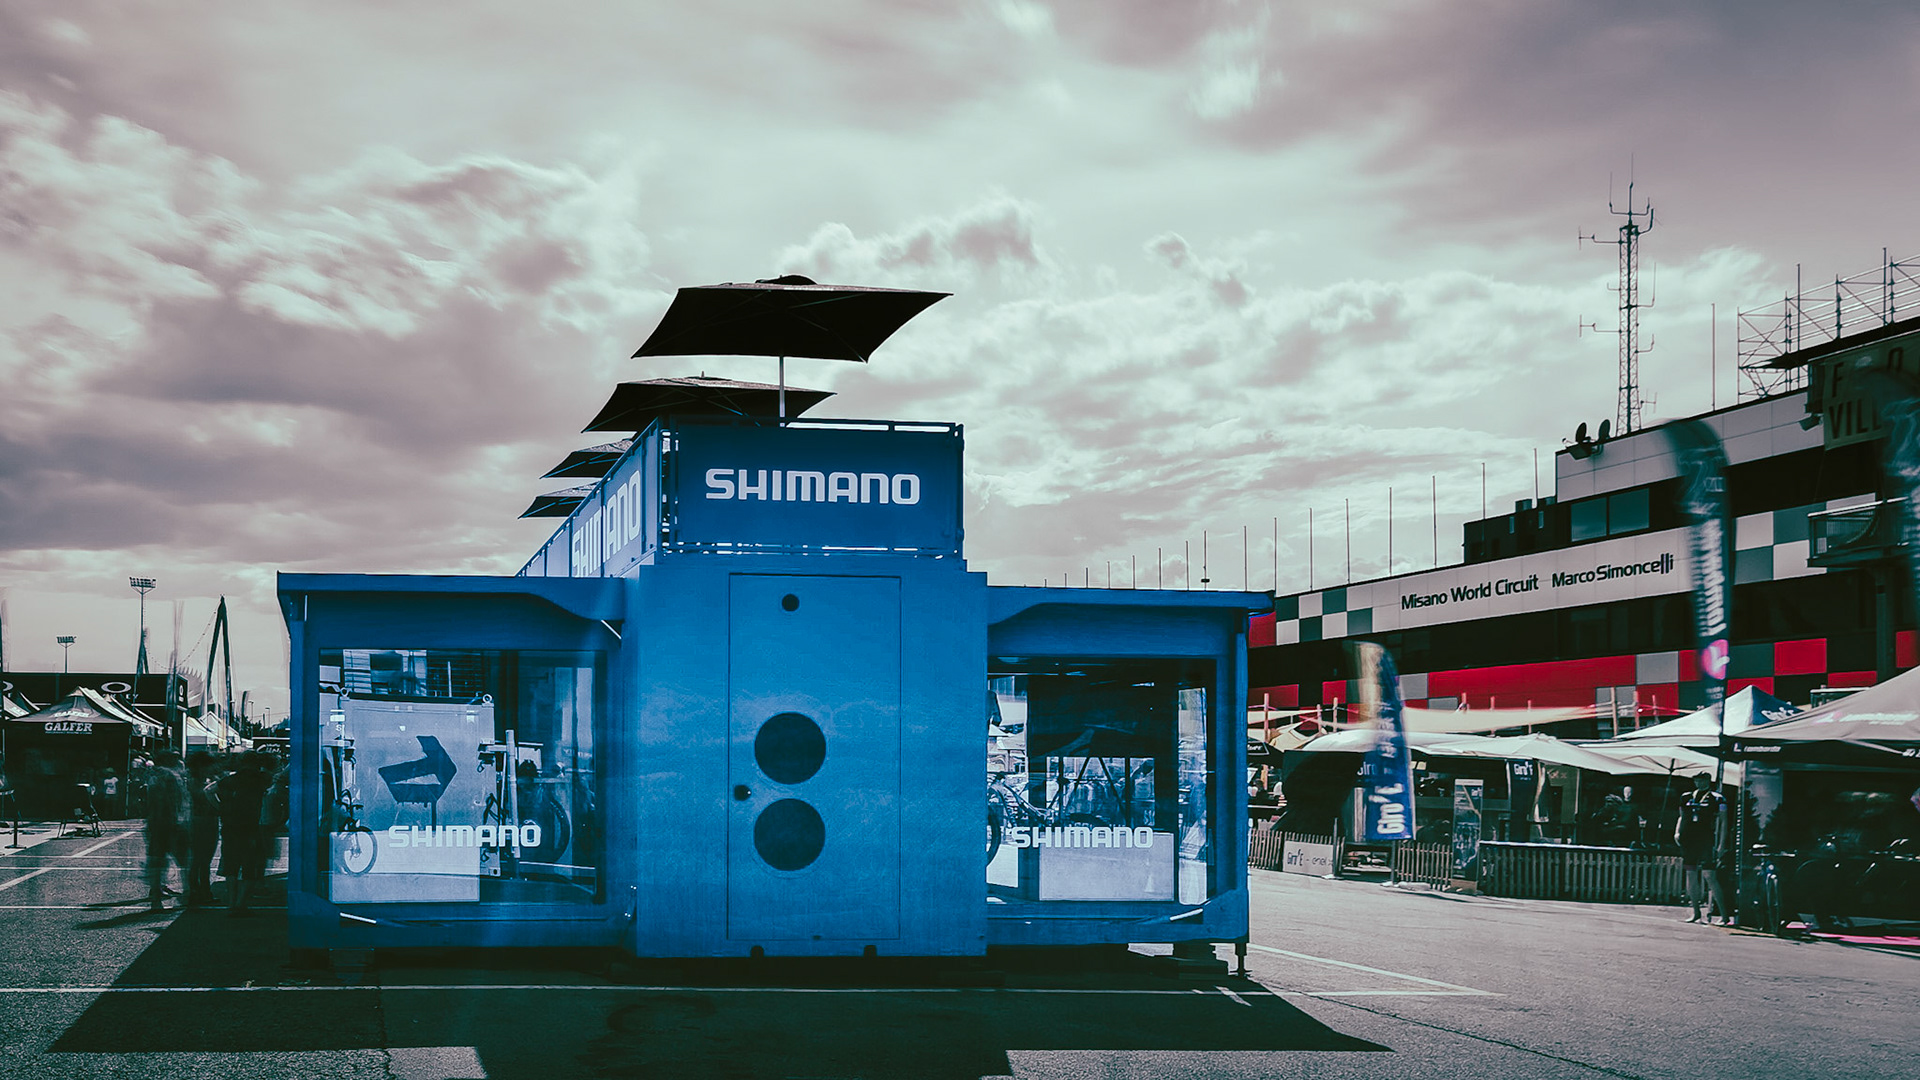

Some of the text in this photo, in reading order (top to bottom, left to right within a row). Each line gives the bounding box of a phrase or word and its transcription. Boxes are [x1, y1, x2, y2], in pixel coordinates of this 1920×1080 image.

[705, 467, 921, 505] SHIMANO
[1401, 552, 1674, 610] Misano World Circuit Marco Simoncelli
[44, 722, 93, 732] GALFER
[388, 824, 541, 848] SHIMANO
[1011, 826, 1154, 848] SHIMANO
